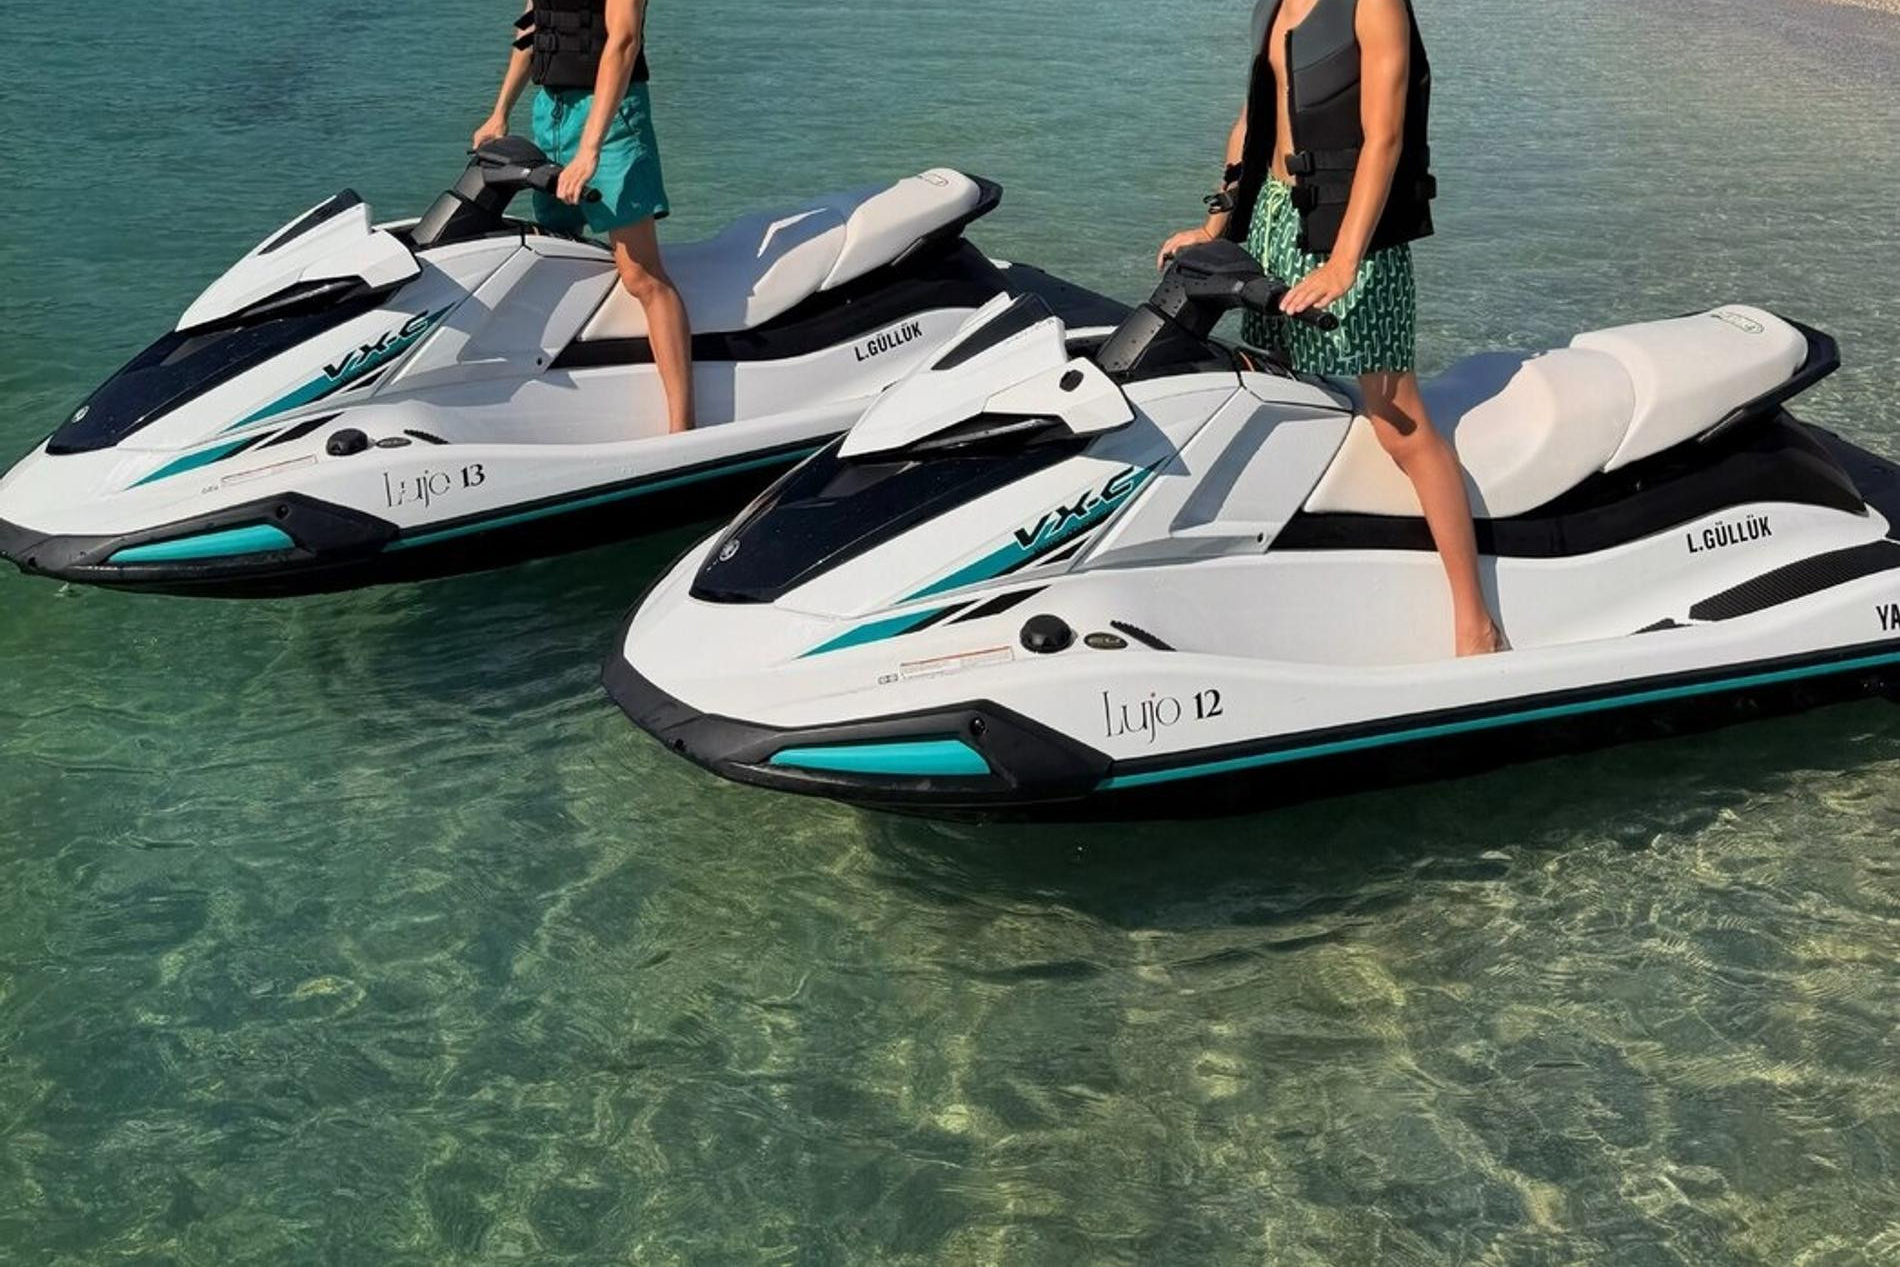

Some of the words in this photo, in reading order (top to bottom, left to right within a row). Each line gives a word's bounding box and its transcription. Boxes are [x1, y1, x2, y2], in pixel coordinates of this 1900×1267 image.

[854, 321, 922, 361] L.GÜLLÜK
[461, 463, 485, 488] 13
[1686, 514, 1772, 553] L.GÜLLÜK
[1876, 604, 1900, 630] YA
[1103, 691, 1181, 743] Lujo
[1195, 689, 1223, 719] 12
